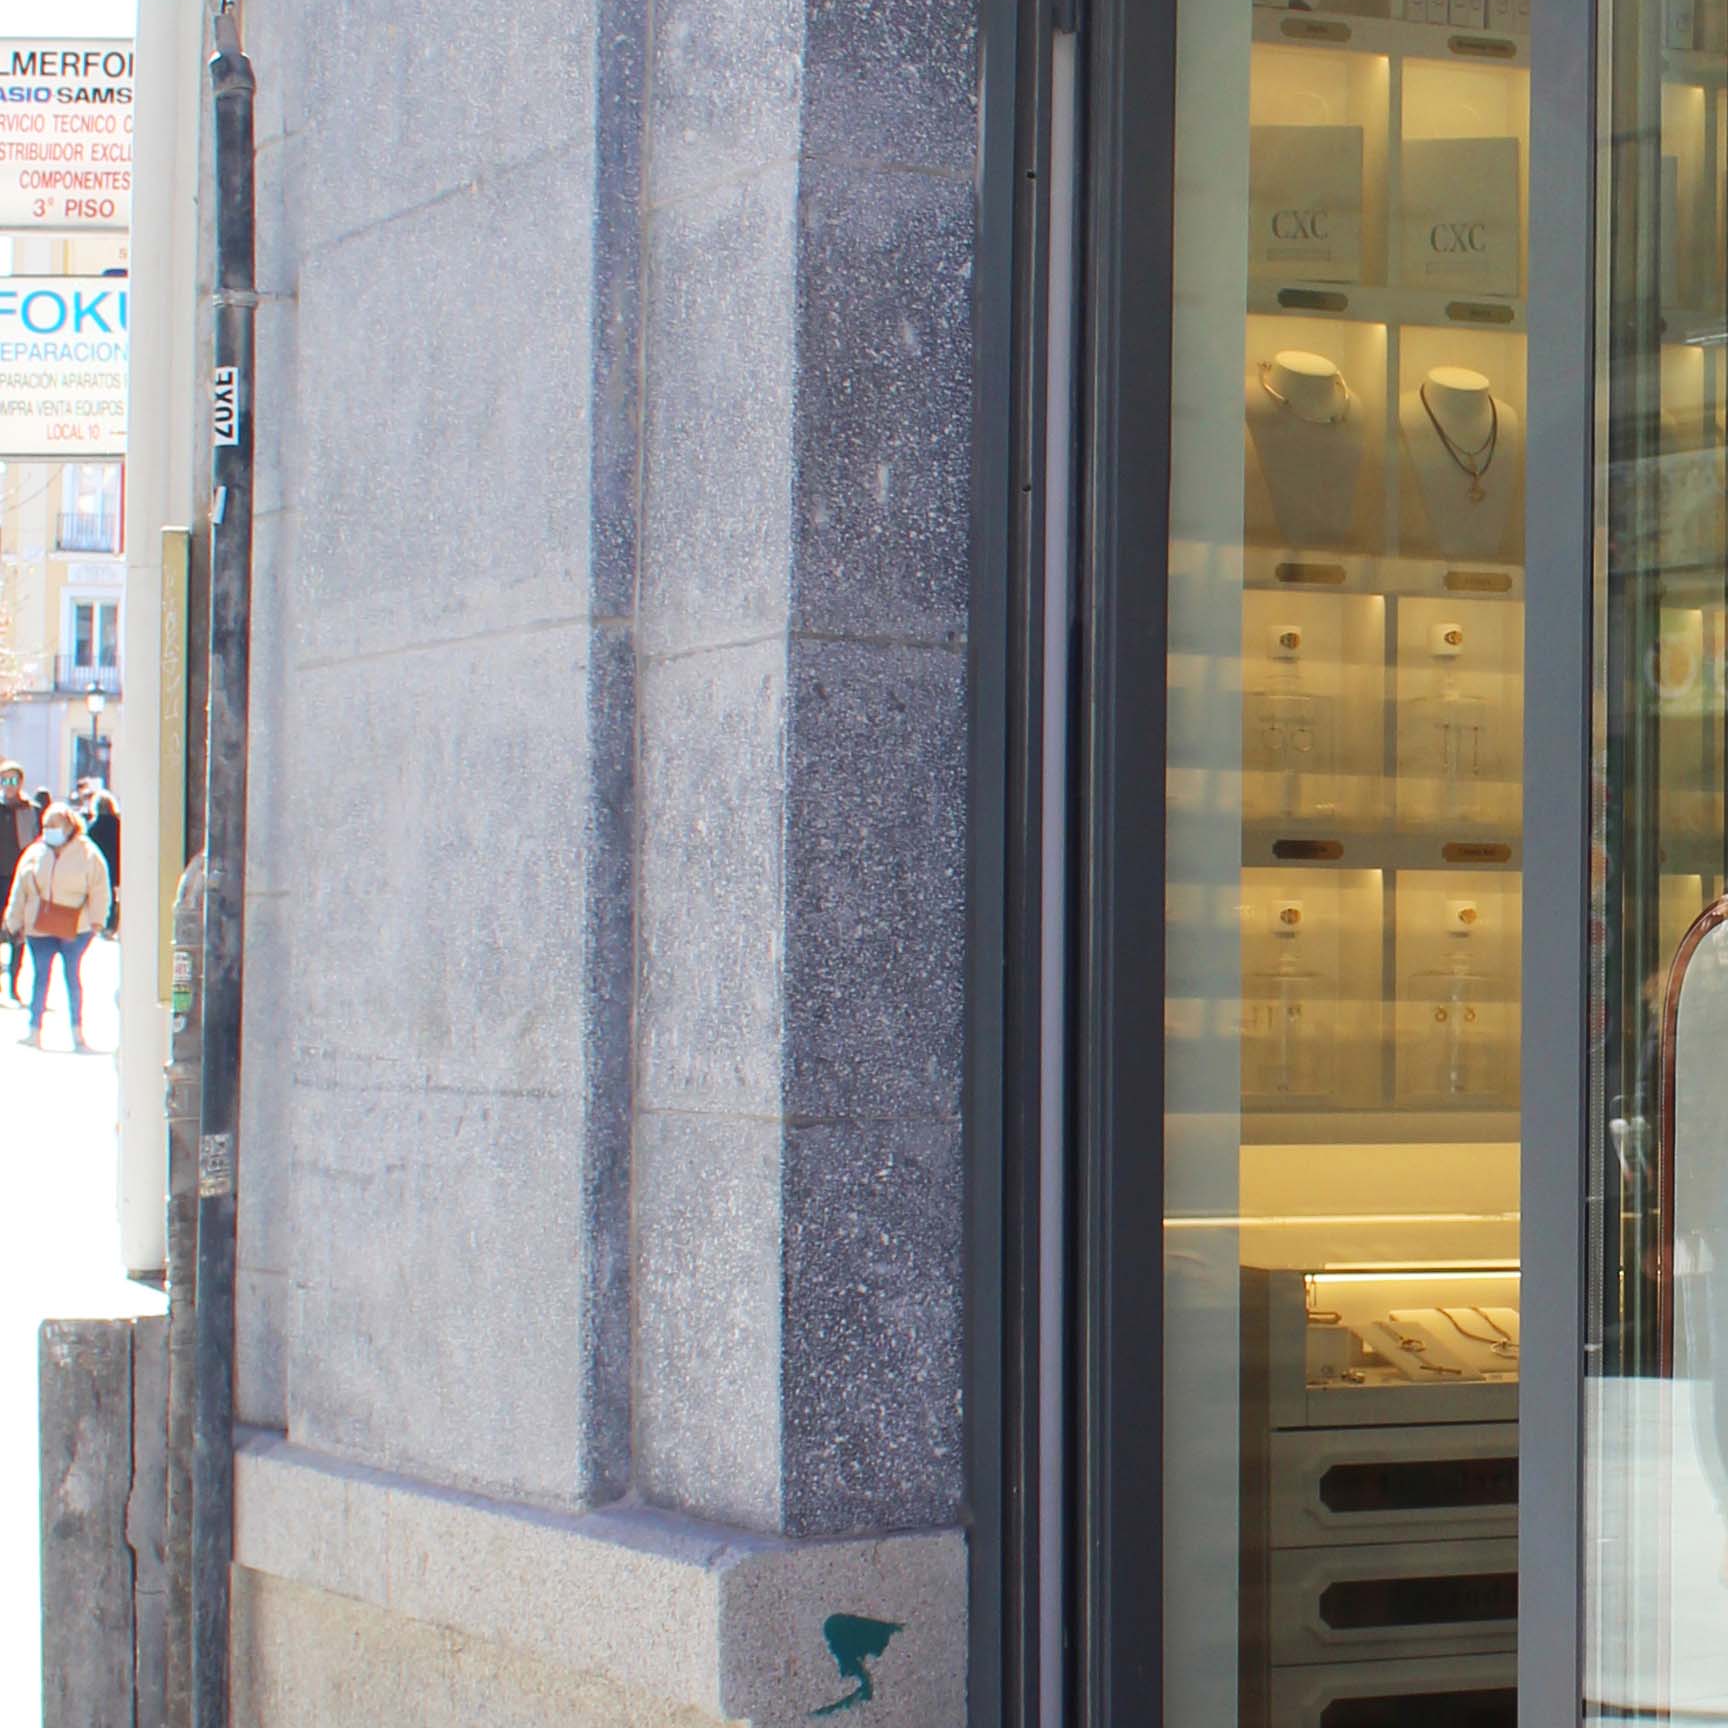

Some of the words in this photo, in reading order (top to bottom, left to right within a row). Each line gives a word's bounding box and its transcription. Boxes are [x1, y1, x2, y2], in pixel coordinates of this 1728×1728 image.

[53, 114, 116, 133] TECNICO
[19, 170, 131, 190] COMPONENTES
[64, 198, 115, 218] PISO
[1271, 209, 1329, 241] CXC
[1430, 223, 1486, 254] CXC
